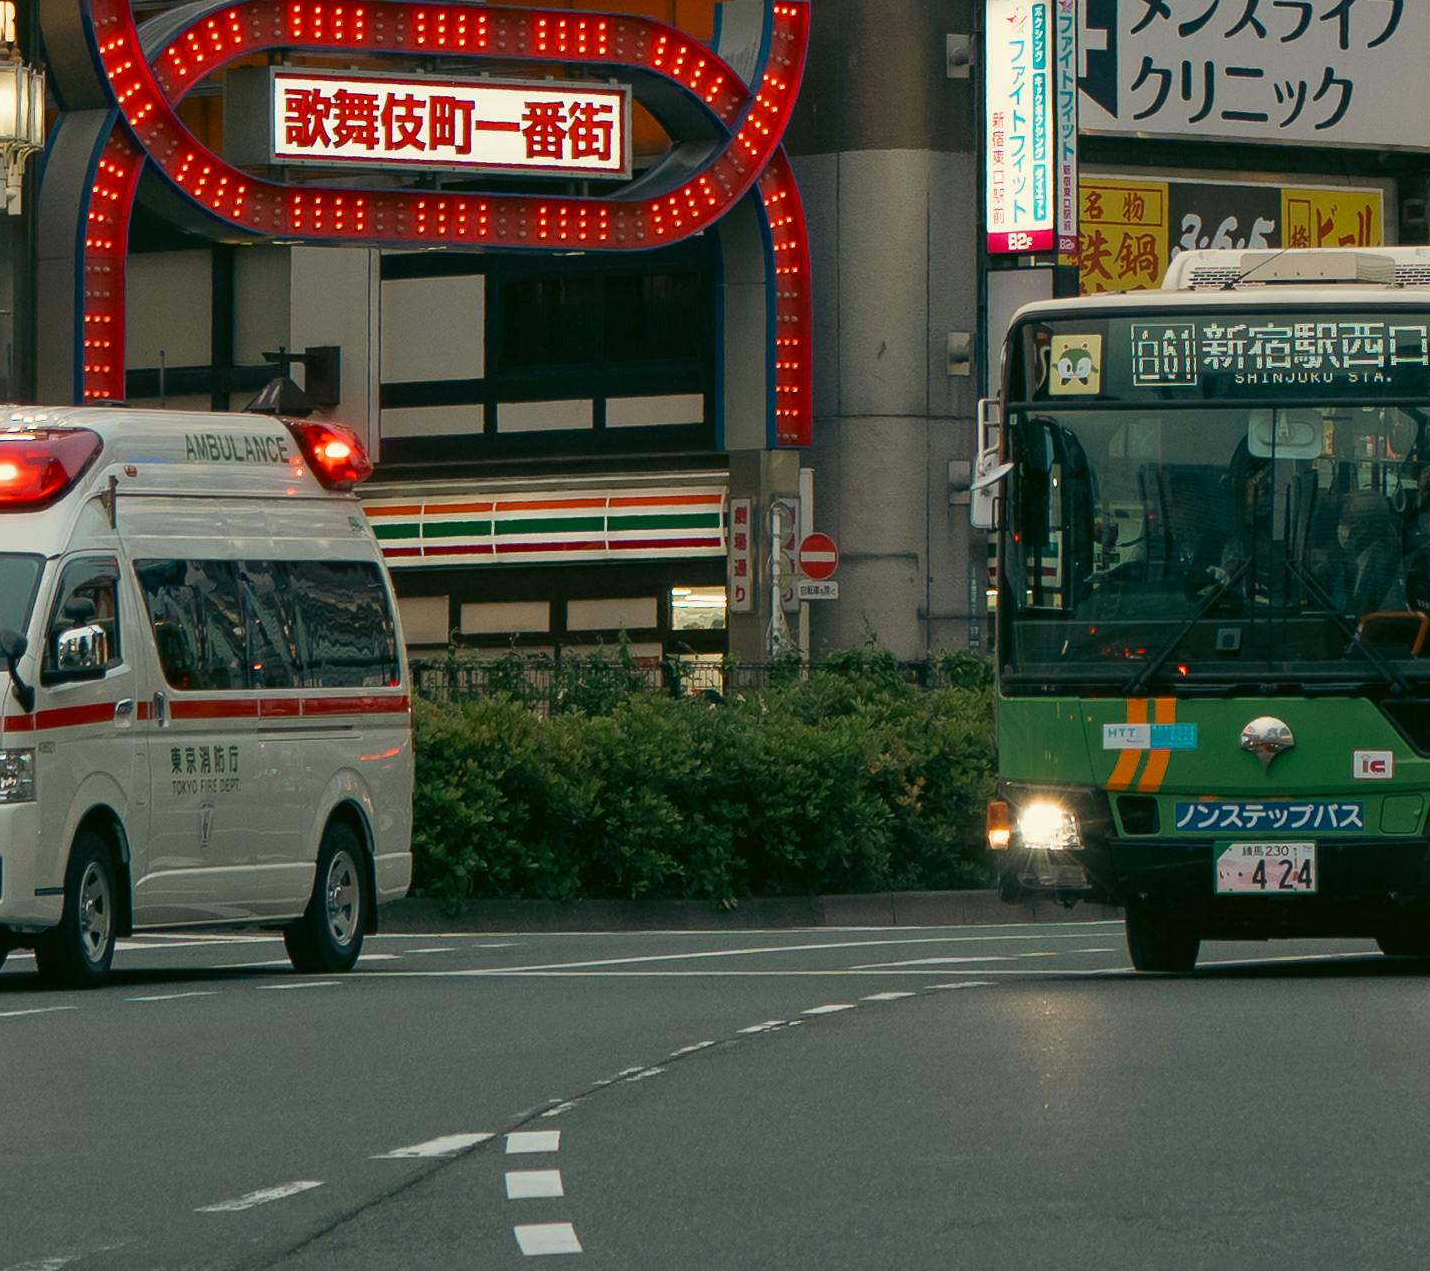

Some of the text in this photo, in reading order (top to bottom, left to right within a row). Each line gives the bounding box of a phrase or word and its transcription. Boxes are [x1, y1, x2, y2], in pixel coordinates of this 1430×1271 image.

[1058, 15, 1075, 161] ファイトフィット
[1130, 58, 1356, 130] クリニック
[284, 87, 613, 161] 歌舞伎町一番街
[1006, 39, 1027, 224] ファイトフィット
[1083, 189, 1147, 222] 名物
[1315, 204, 1381, 248] ビール
[1202, 321, 1430, 370] 新宿駅西口
[1349, 371, 1393, 384] STA.
[185, 432, 291, 464] AMBULANCE
[170, 745, 240, 776] 東京消防庁
[171, 779, 218, 796] TOKYO FIRE
[1176, 803, 1364, 830] ノンステップバス
